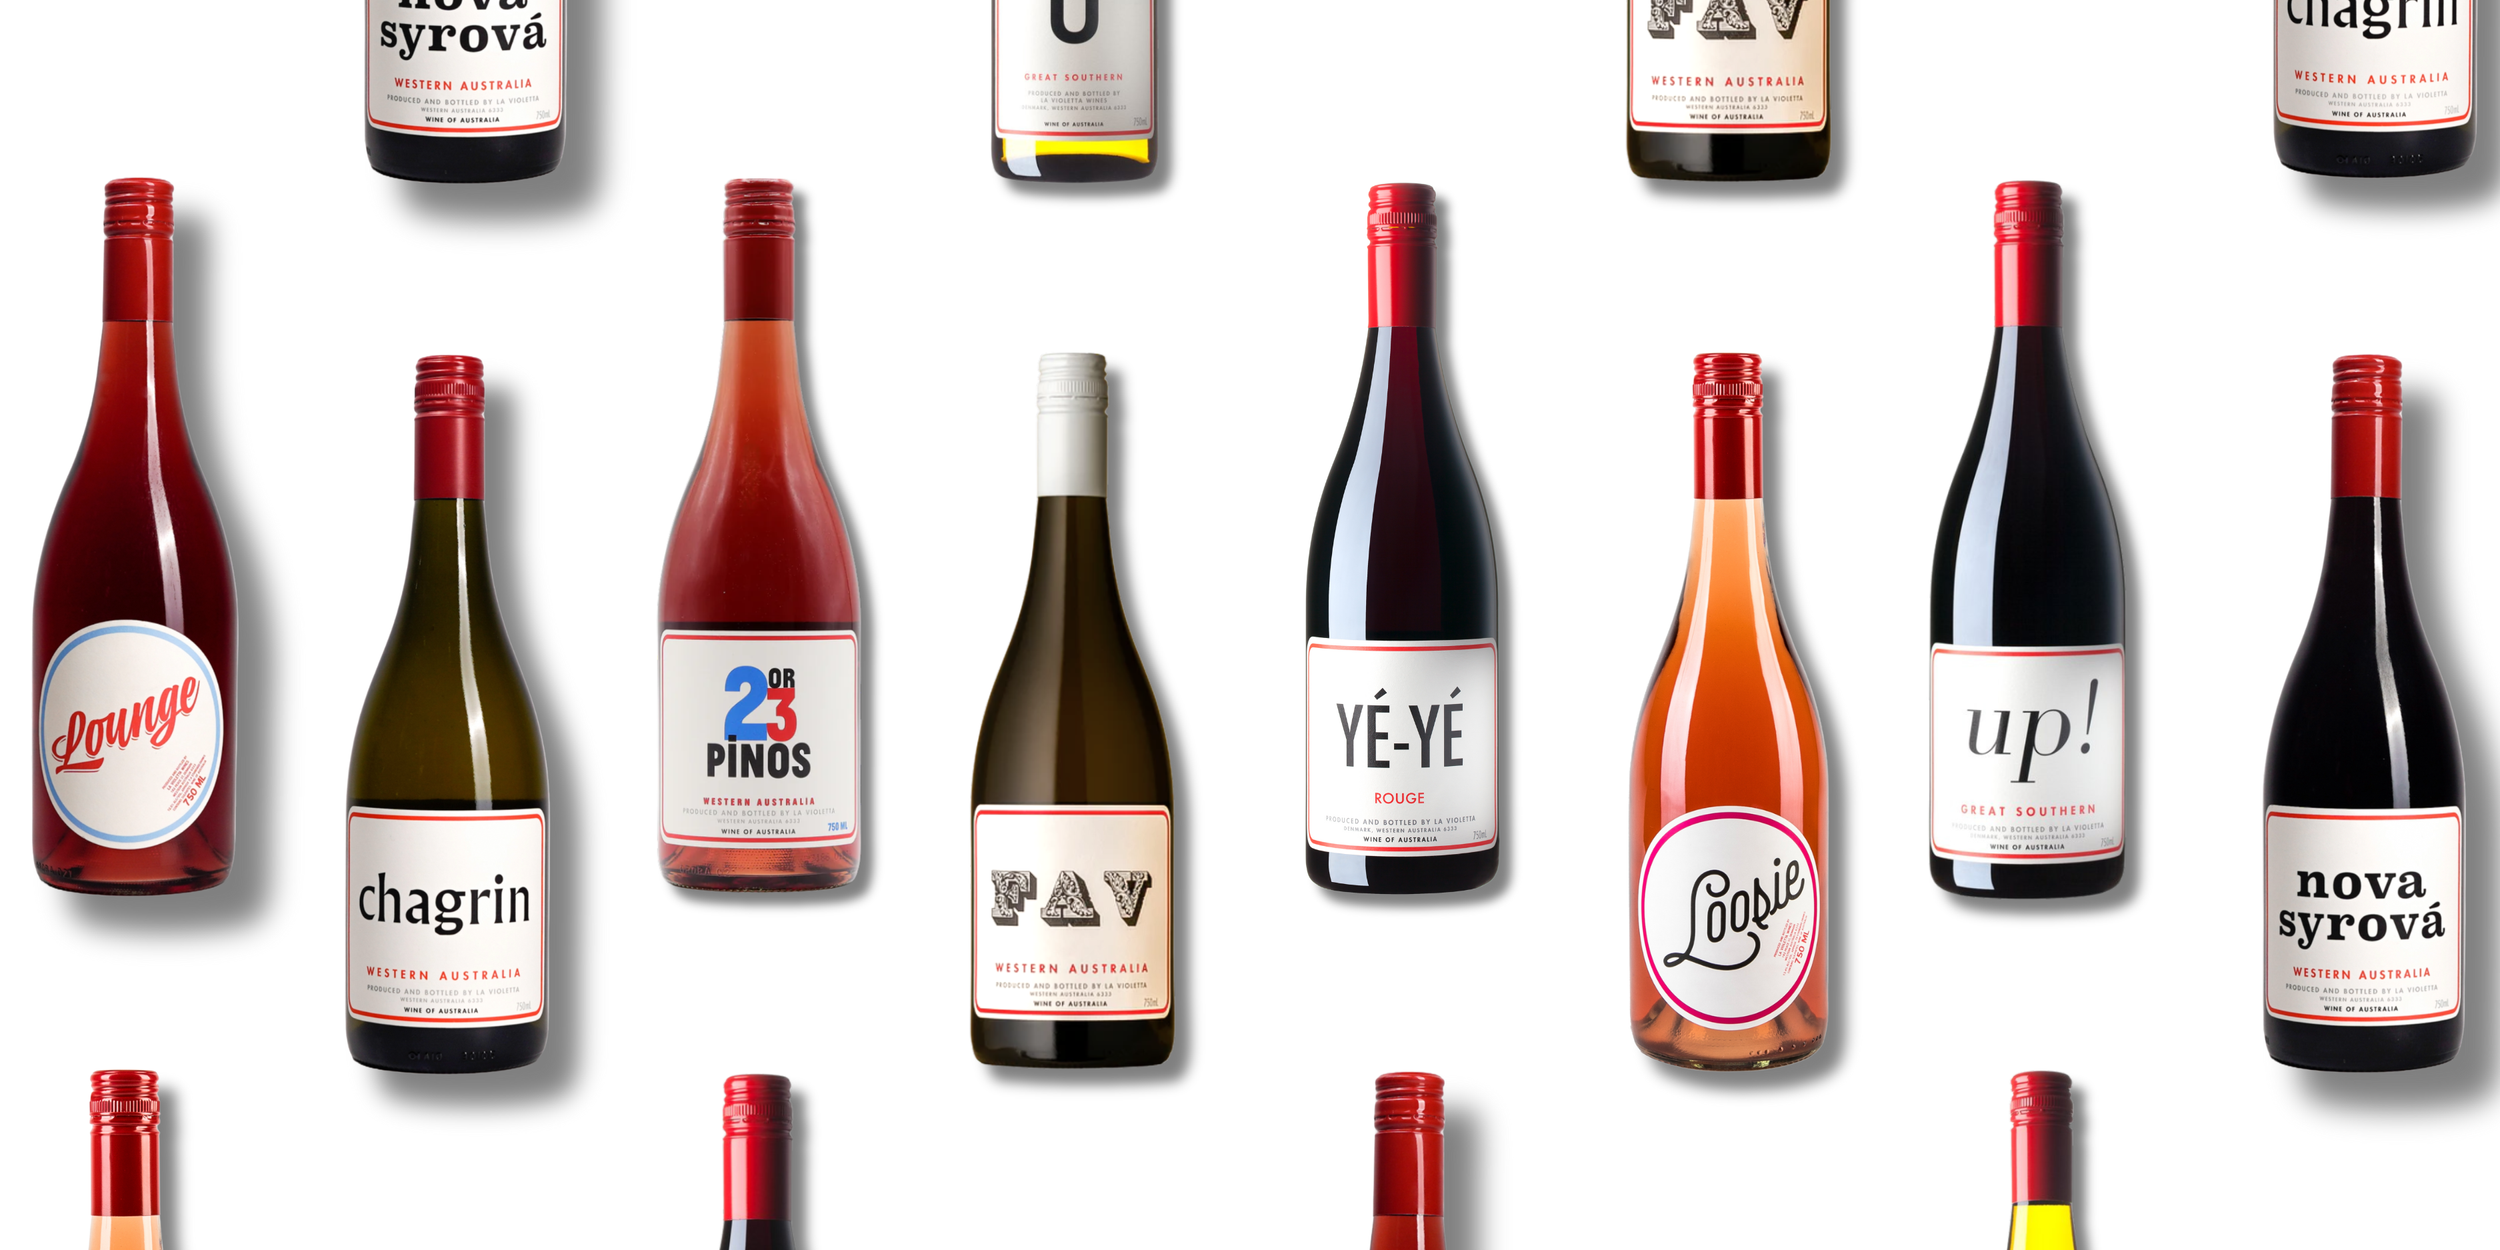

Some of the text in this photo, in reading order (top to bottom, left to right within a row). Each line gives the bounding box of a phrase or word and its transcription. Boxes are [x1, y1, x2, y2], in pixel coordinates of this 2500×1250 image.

[1647, 0, 1810, 40] FAV
[380, 12, 548, 61] syrová
[394, 77, 532, 91] WESTERN AUSTRALIA
[1024, 73, 1123, 82] GREAT SOUTHERN
[1651, 76, 1804, 87] WESTERN AUSTRALIA
[2294, 70, 2448, 85] WESTERN AUSTRALIA
[387, 94, 421, 104] PRODUCED
[508, 95, 539, 104] VIOLETTA
[2295, 88, 2329, 98] PRODUCED
[2416, 90, 2448, 99] VIOLETTA
[724, 665, 797, 742] 2 OR 3
[51, 676, 200, 775] Lounge
[1336, 686, 1464, 769] YÉ-YÉ
[1966, 678, 2099, 784] up!
[182, 774, 207, 807] 750 ML
[703, 797, 815, 806] WESTERN AUSTRALIA
[1375, 792, 1424, 804] ROUGE
[682, 807, 718, 816] PRODUCED
[805, 808, 835, 816] VIOLETTA
[1961, 804, 2095, 817] GREAT SOUTHERN
[827, 821, 848, 832] 750 ML
[1326, 815, 1360, 825] PRODUCED
[1446, 815, 1476, 824] VIOLETTA
[1952, 822, 1986, 832] PRODUCED
[2074, 822, 2104, 831] VIOLETTA
[2296, 870, 2427, 900] nova
[358, 871, 530, 936] chagrin
[990, 869, 1152, 927] FAV
[1663, 857, 1805, 971] Loosie
[2279, 901, 2446, 950] syrová
[1793, 930, 1811, 965] 750 ML
[366, 966, 520, 981] WESTERN AUSTRALIA
[995, 963, 1148, 974] WESTERN AUSTRALIA
[2293, 966, 2430, 980] WESTERN AUSTRALIA
[367, 984, 401, 994] PRODUCED
[488, 986, 520, 995] VIOLETTA
[2286, 983, 2320, 993] PRODUCED
[2407, 984, 2438, 993] VIOLETTA
